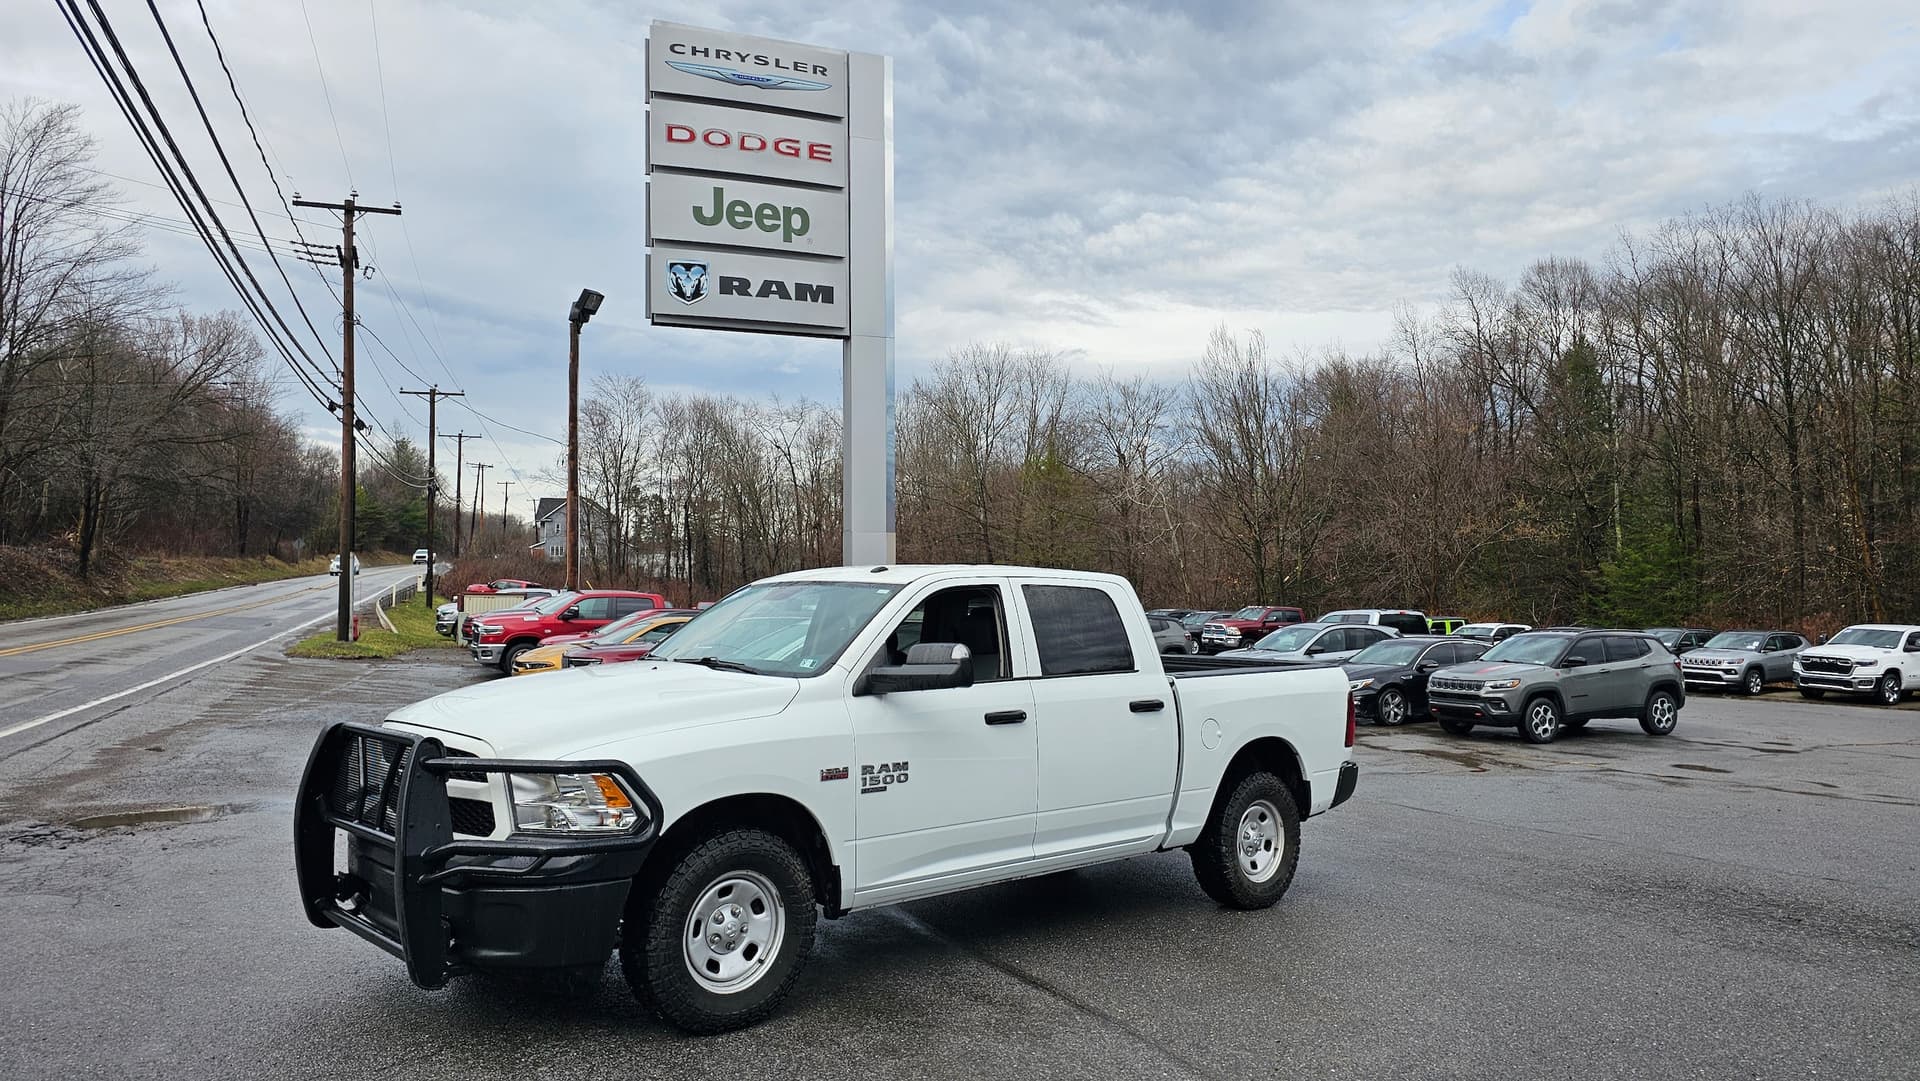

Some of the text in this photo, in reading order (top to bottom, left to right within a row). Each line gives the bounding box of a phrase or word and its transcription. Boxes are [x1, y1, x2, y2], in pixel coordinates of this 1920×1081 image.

[669, 43, 829, 77] CHRYSLER
[665, 124, 832, 163] DODGE
[692, 187, 810, 243] Jeep
[719, 275, 834, 304] RAM
[861, 761, 909, 775] RAM
[861, 773, 909, 787] 1500
